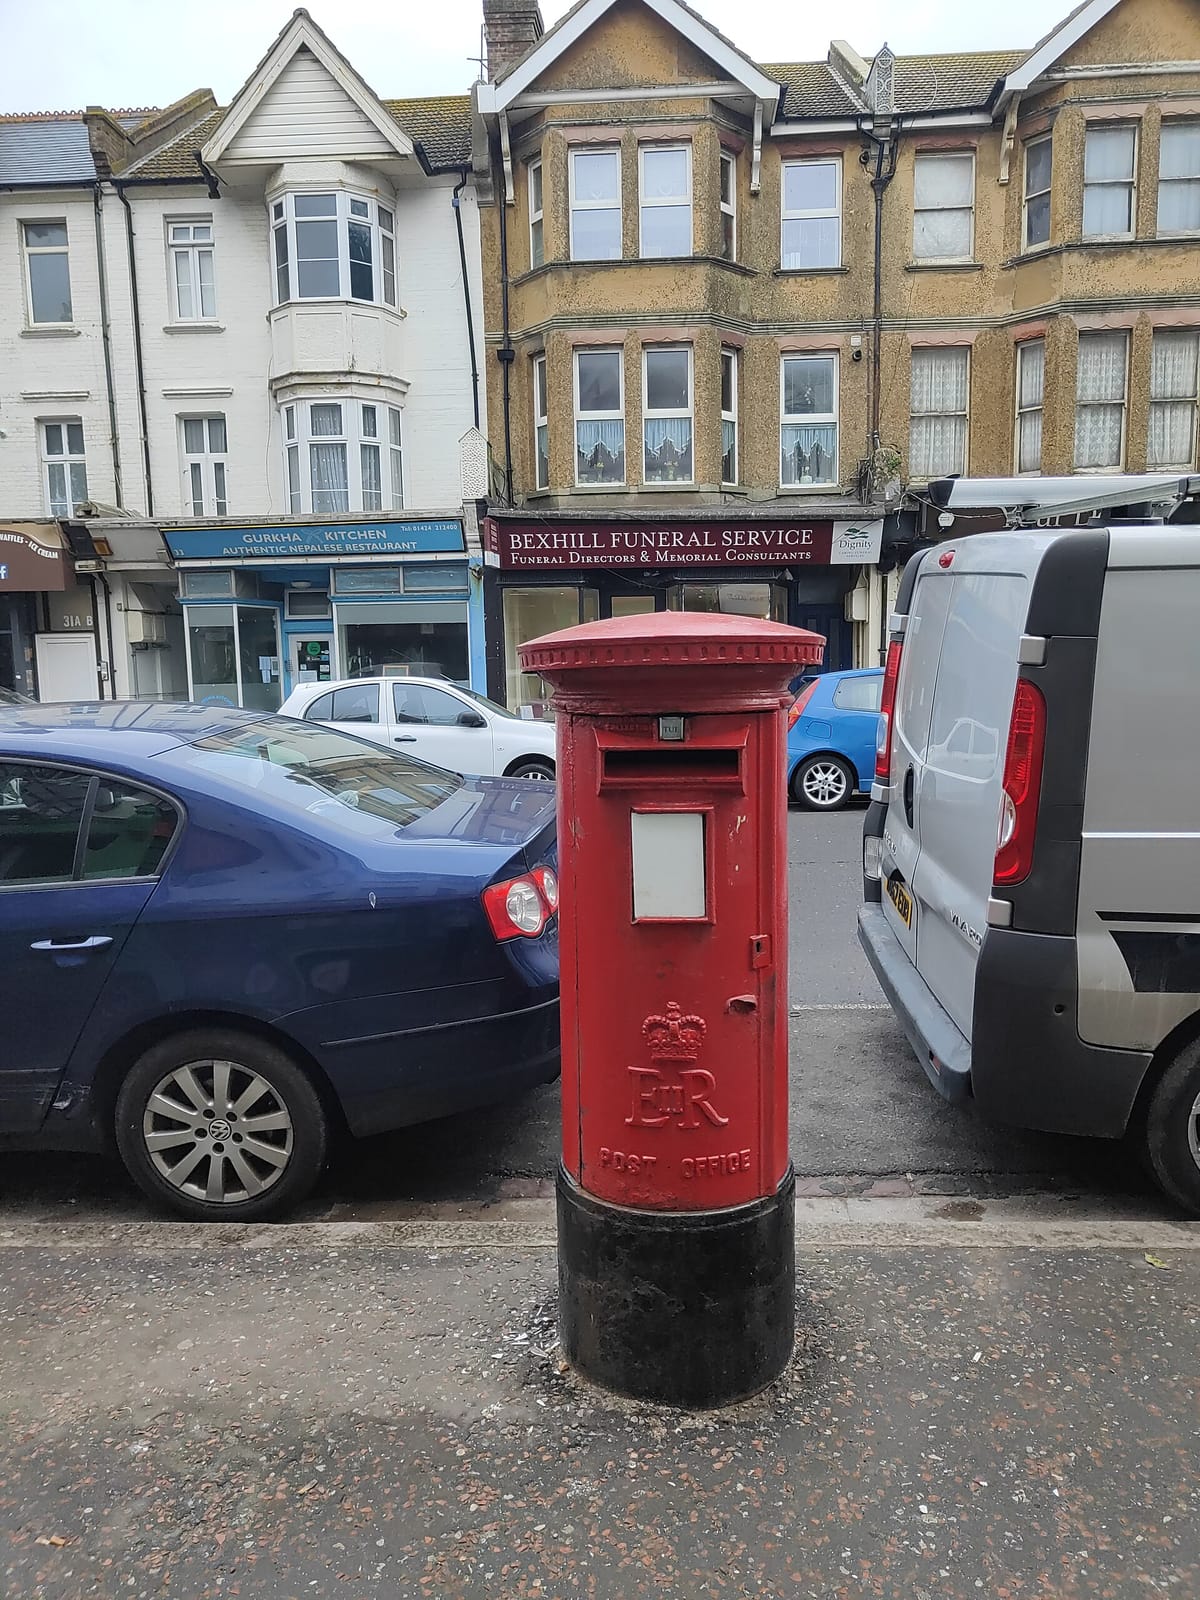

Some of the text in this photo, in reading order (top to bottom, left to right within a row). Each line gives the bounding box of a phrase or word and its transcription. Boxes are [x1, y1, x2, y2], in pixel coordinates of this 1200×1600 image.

[242, 529, 387, 544] GURKHA KITCHEN
[509, 532, 605, 549] BEXHILL
[610, 531, 716, 548] FUNERAL
[721, 529, 813, 546] SERVICE
[28, 541, 39, 552] ICE
[37, 548, 58, 559] CREAM
[222, 541, 417, 555] AUTHENTIC NEPALESE RESTAURANT
[839, 540, 873, 550] Dignity
[640, 550, 651, 562] &
[63, 615, 93, 627] 31A B
[600, 1147, 751, 1179] POST OFFICE
